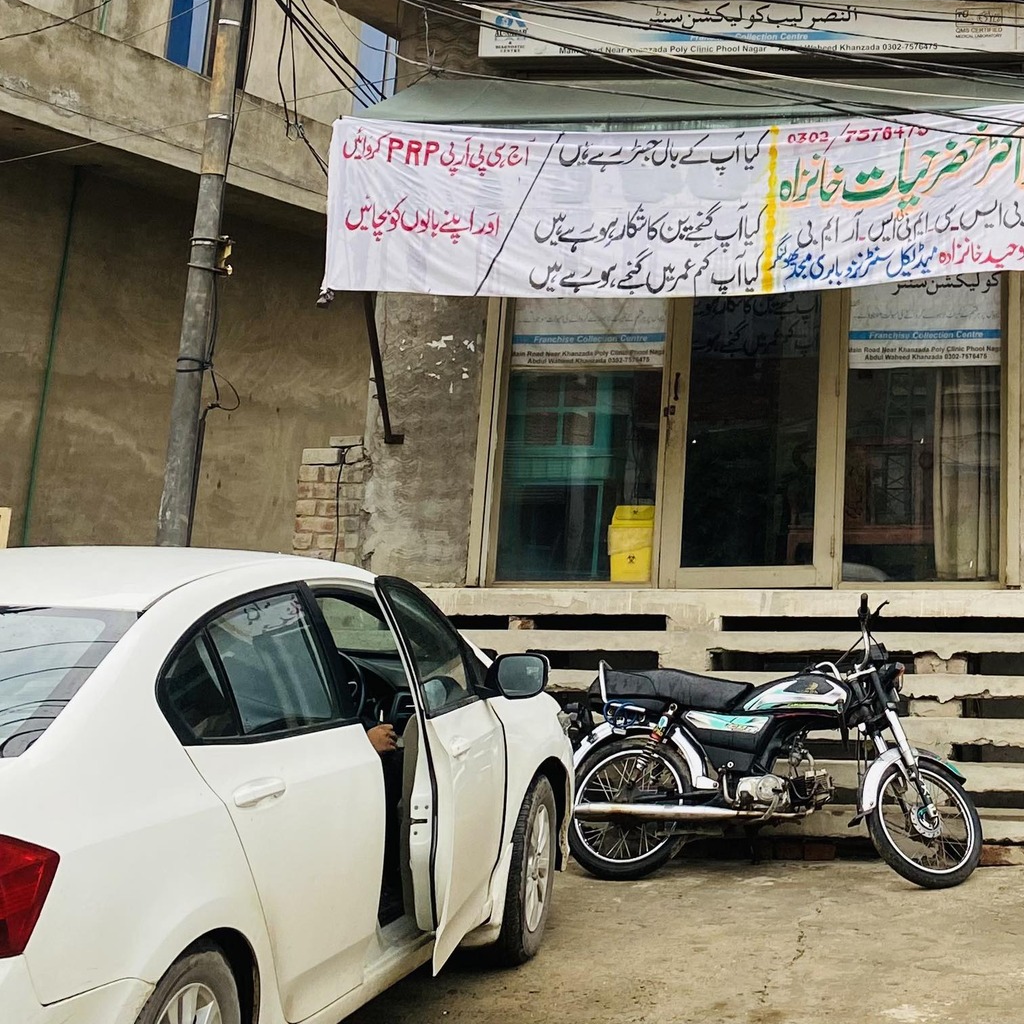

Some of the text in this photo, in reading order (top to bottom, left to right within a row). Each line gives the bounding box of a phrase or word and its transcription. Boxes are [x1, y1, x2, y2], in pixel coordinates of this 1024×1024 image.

[670, 45, 687, 54] Poly
[690, 45, 713, 53] Clinic
[716, 45, 740, 53] Phool
[742, 45, 766, 54] Nagar
[840, 43, 880, 52] Khanzada
[387, 138, 440, 166] PRP
